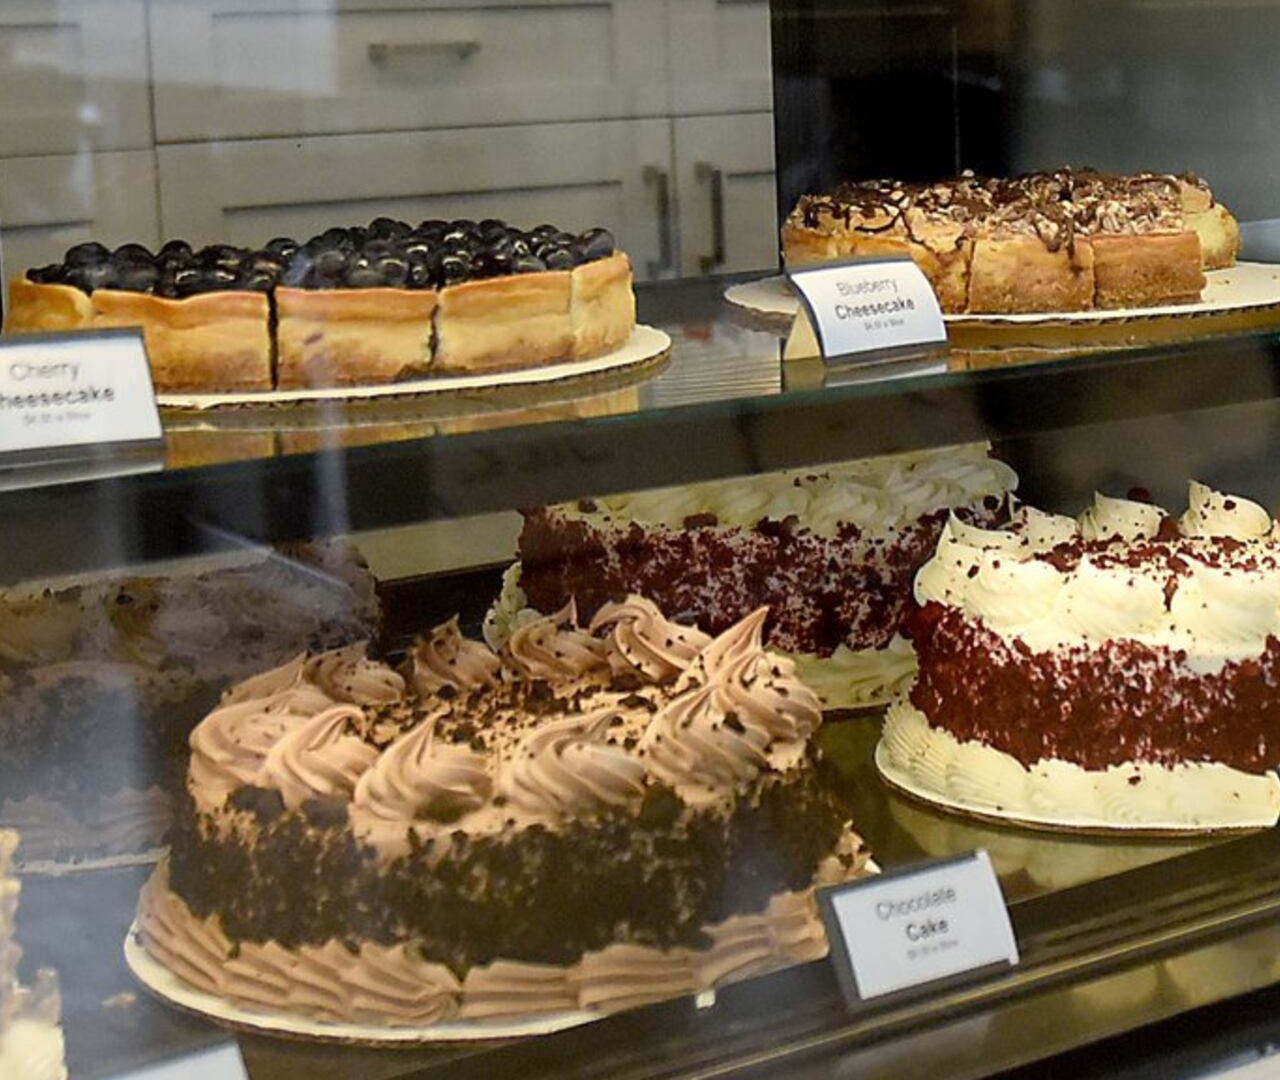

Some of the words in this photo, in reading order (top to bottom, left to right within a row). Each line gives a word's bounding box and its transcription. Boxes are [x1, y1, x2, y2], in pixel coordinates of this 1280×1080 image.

[835, 278, 899, 297] Blueberry
[834, 297, 916, 320] Cheesecake
[9, 361, 80, 381] Cherry
[875, 886, 958, 921] Chocolate
[905, 918, 950, 942] Cake
